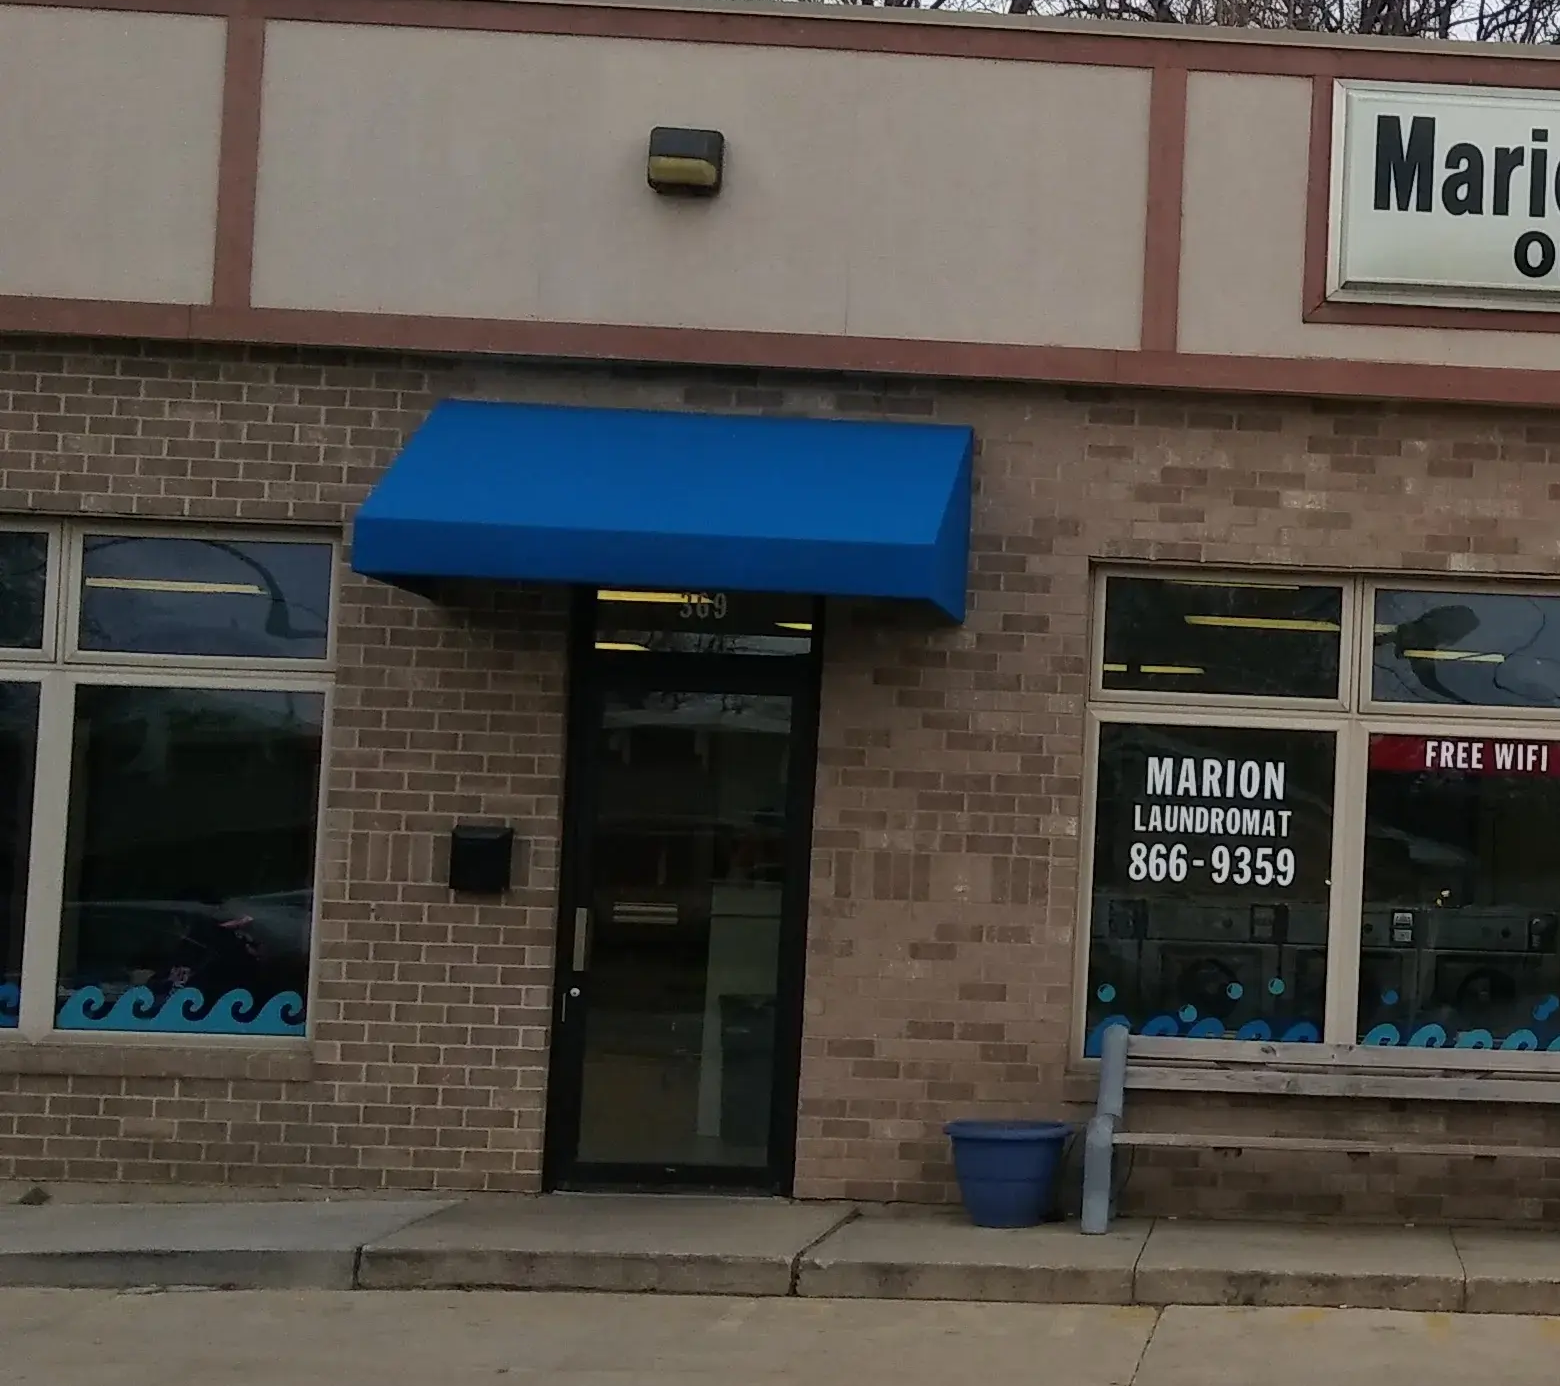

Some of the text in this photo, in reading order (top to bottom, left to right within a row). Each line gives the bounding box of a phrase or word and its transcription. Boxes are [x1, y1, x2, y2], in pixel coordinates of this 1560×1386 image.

[1425, 740, 1549, 772] FREE WIFI
[1146, 756, 1286, 801] MARION
[1134, 804, 1292, 838] LAUNDROMAT
[1128, 842, 1296, 887] 866-9359
